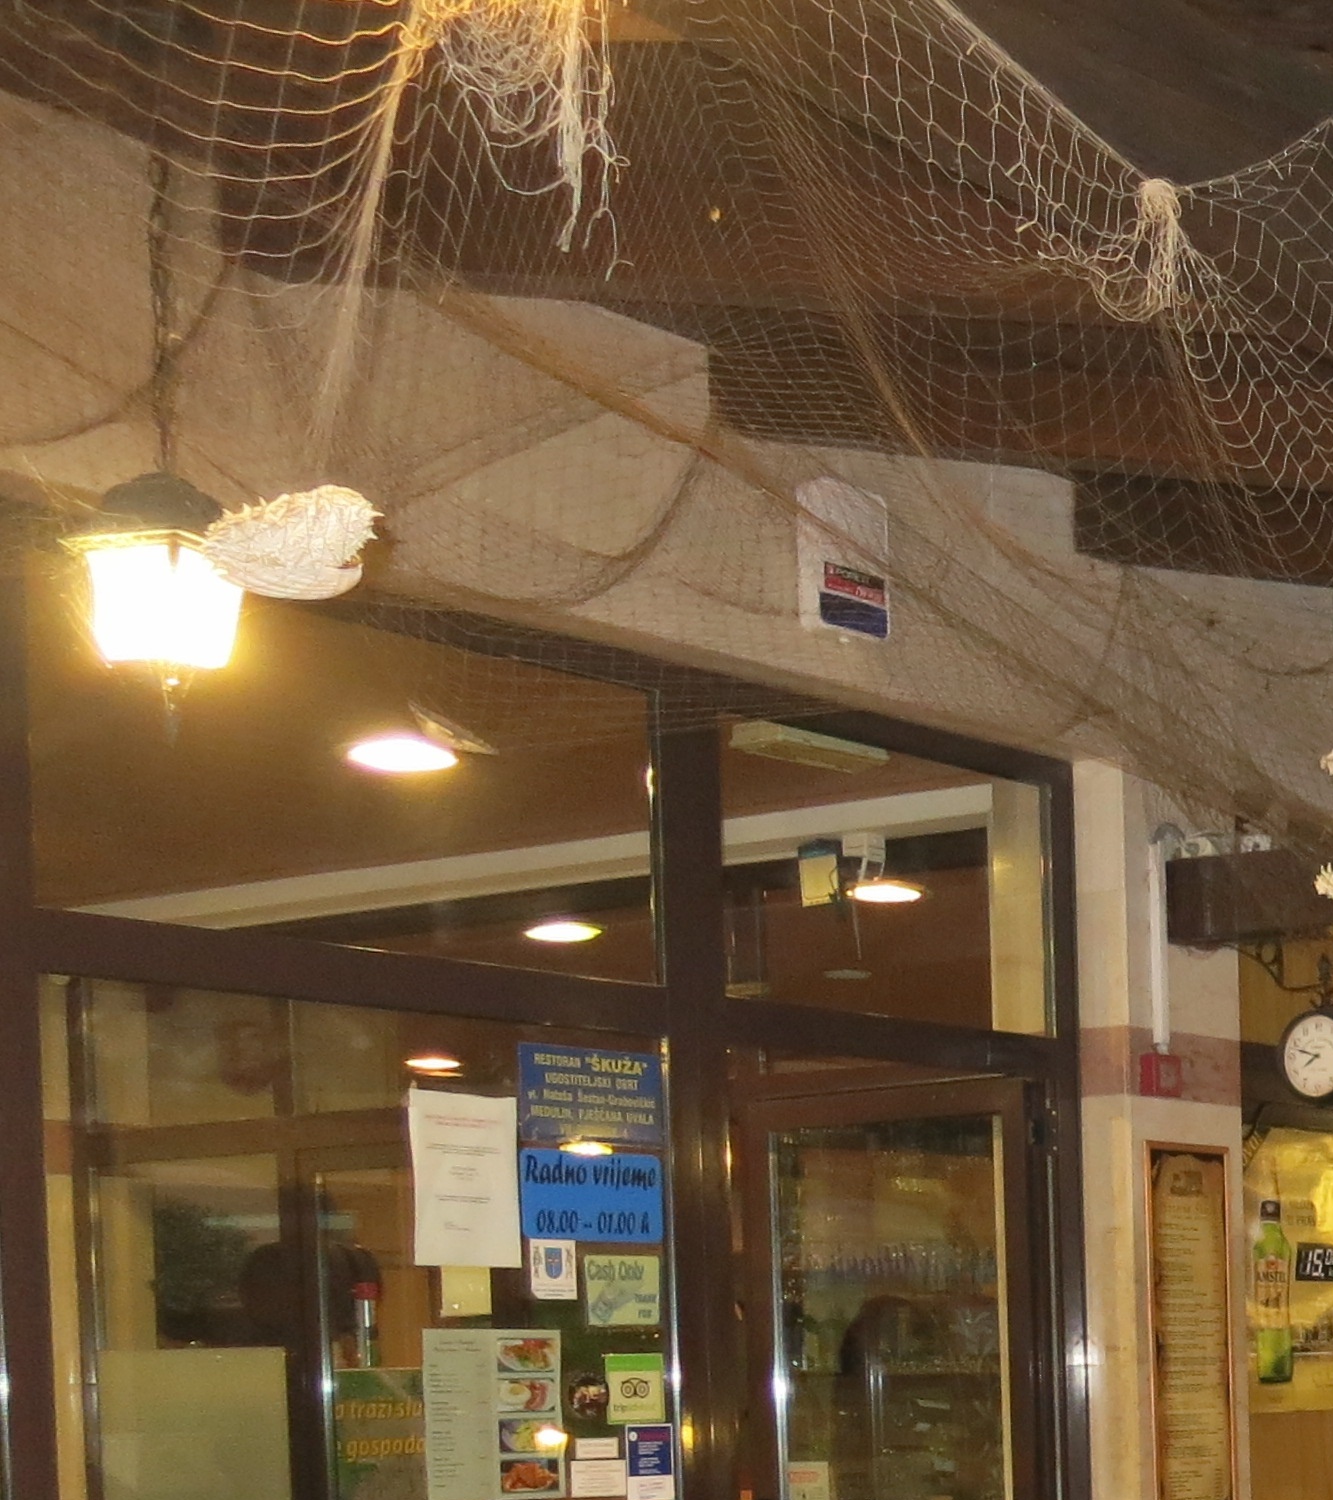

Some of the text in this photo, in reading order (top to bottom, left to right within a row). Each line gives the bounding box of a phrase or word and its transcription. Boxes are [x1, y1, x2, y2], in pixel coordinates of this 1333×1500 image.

[534, 1052, 581, 1068] RESTORAN
[545, 1072, 612, 1089] UGOSTITELJSKI
[626, 1113, 655, 1125] UVALA
[525, 1154, 657, 1191] Radno vrijeme
[536, 1209, 579, 1234] 08.00
[597, 1211, 636, 1235] 01.00
[587, 1260, 645, 1283] Cash Only
